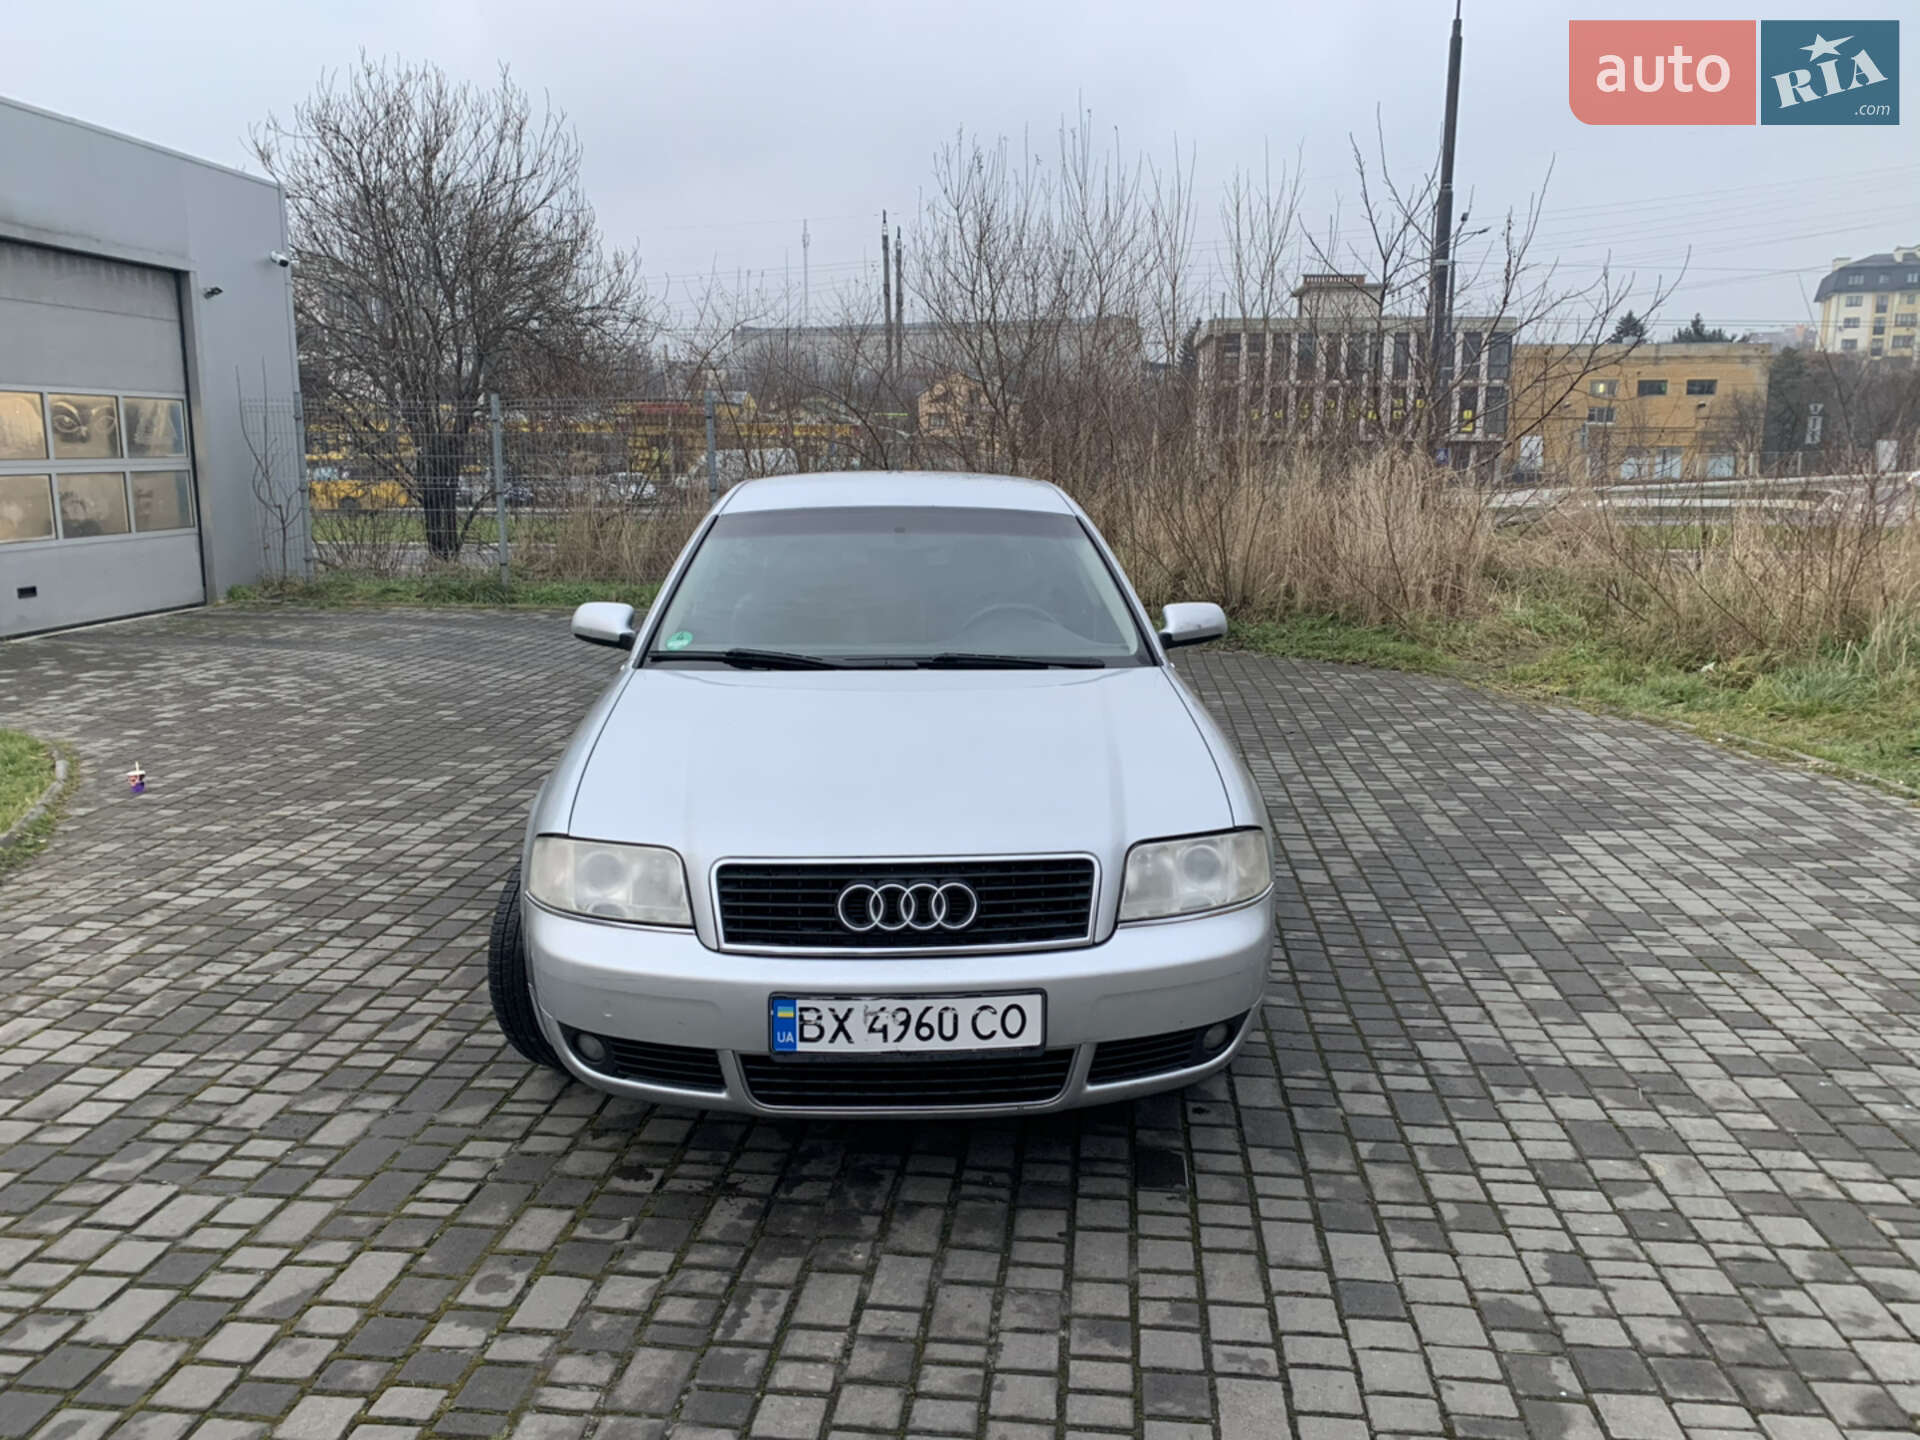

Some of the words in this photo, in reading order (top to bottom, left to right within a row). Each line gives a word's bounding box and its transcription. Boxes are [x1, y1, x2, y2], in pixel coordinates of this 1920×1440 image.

[798, 1006, 854, 1044] BX
[866, 1005, 959, 1043] 4960
[971, 1003, 1027, 1041] CO
[776, 1031, 794, 1043] UA
